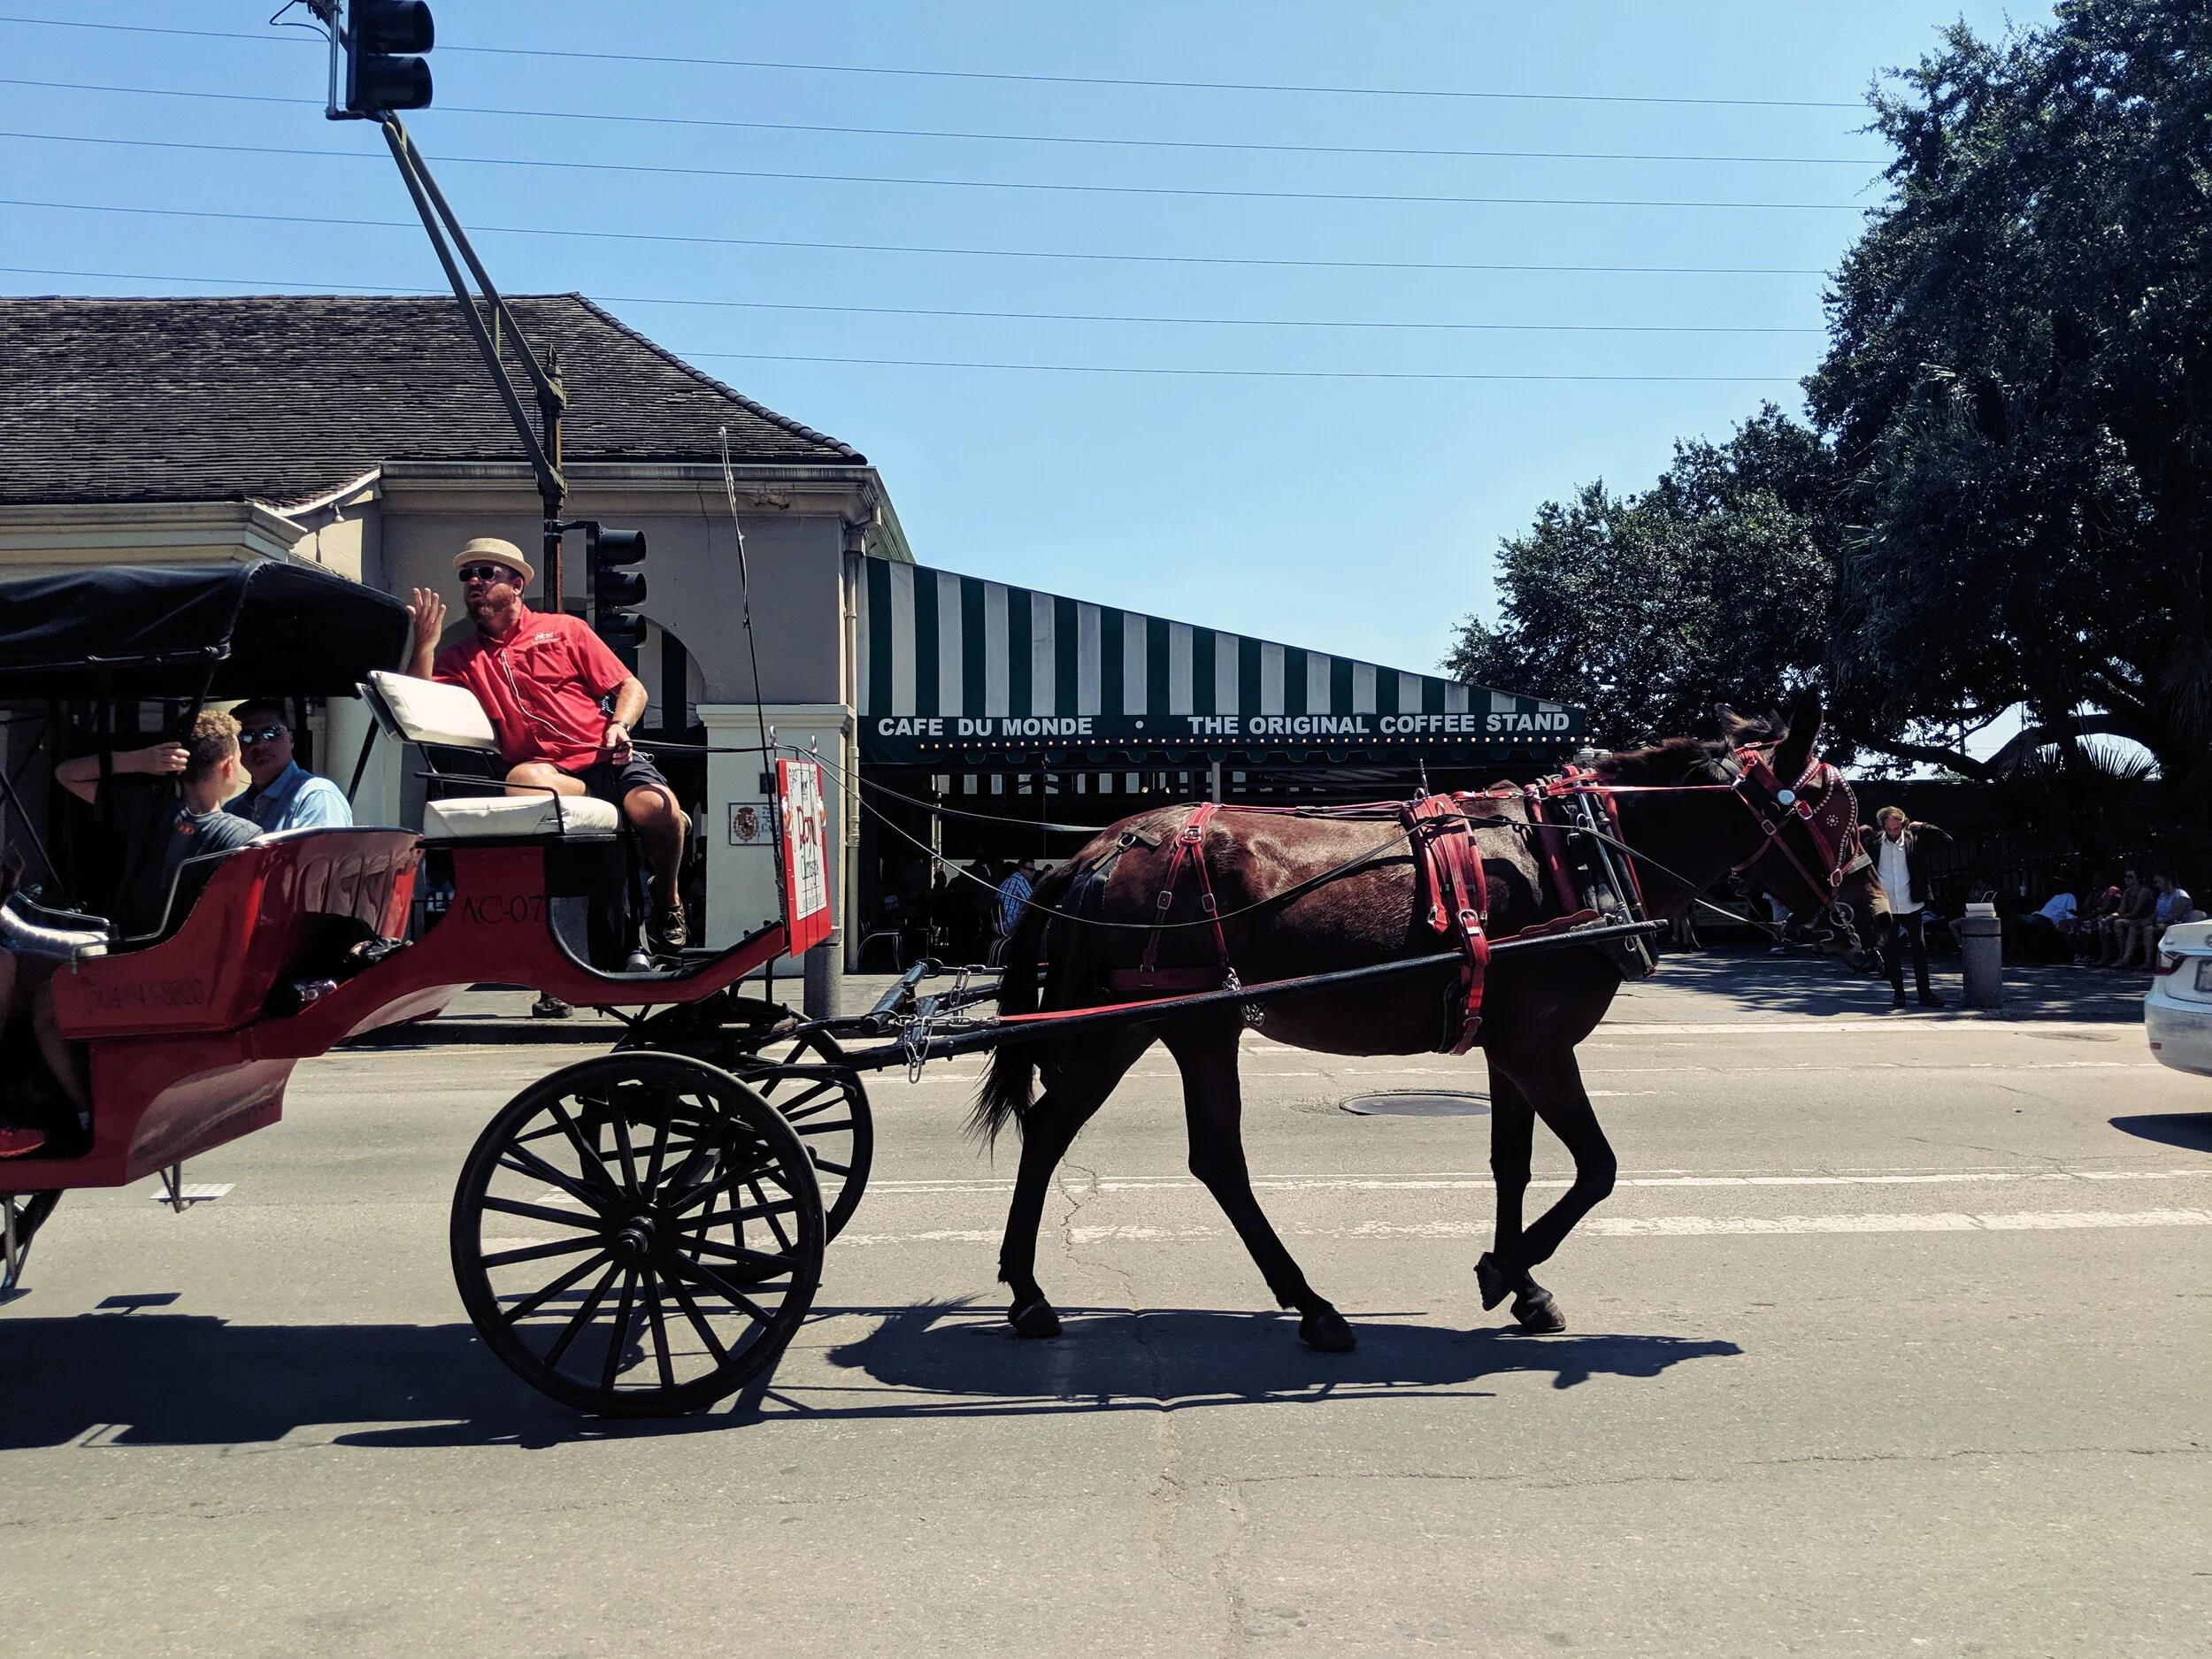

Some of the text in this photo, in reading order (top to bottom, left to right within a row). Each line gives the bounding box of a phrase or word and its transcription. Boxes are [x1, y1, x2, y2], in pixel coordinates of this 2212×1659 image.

[878, 717, 1093, 736] CAFE DU MONDE
[1187, 712, 1571, 735] THE ORIGINAL COFFEE STAND
[462, 895, 545, 924] AC-07
